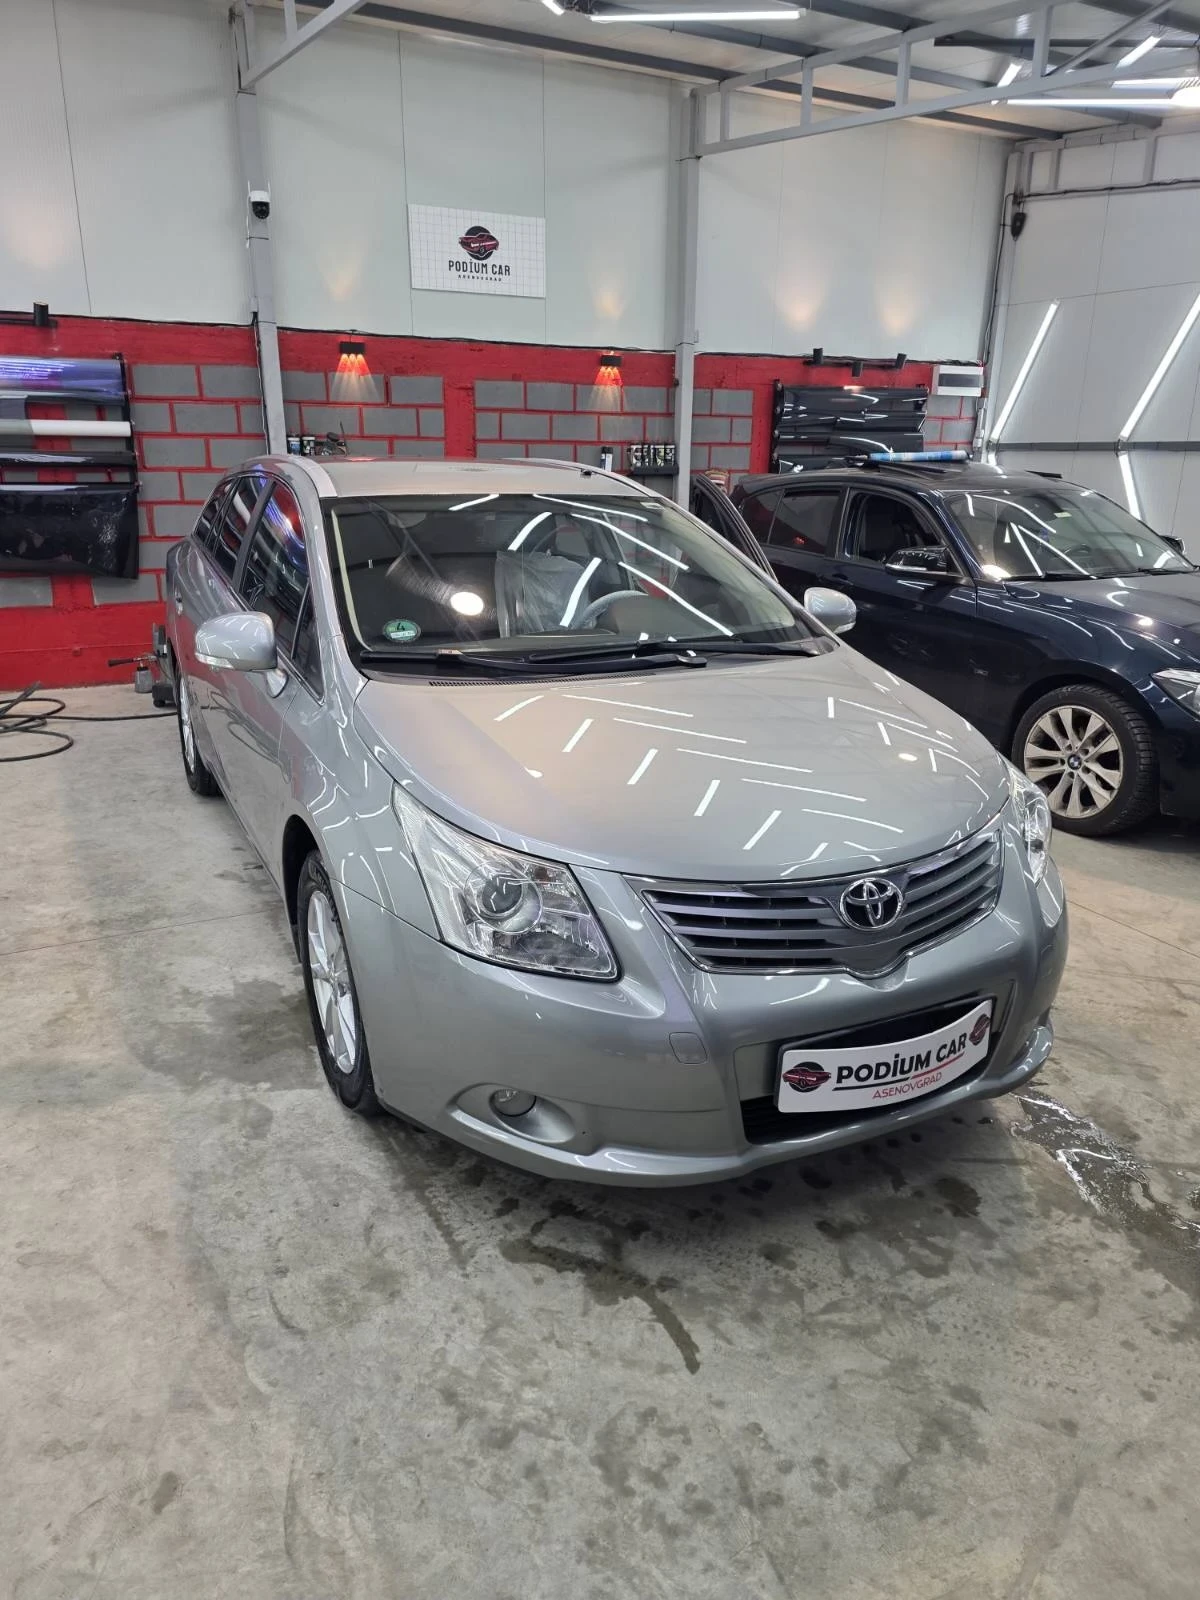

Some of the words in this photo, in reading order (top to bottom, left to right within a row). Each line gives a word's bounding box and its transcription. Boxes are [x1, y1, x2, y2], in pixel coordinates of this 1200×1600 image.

[491, 263, 511, 276] CAR
[936, 1032, 967, 1062] CAR
[872, 1072, 942, 1099] ASENOVGRAD
